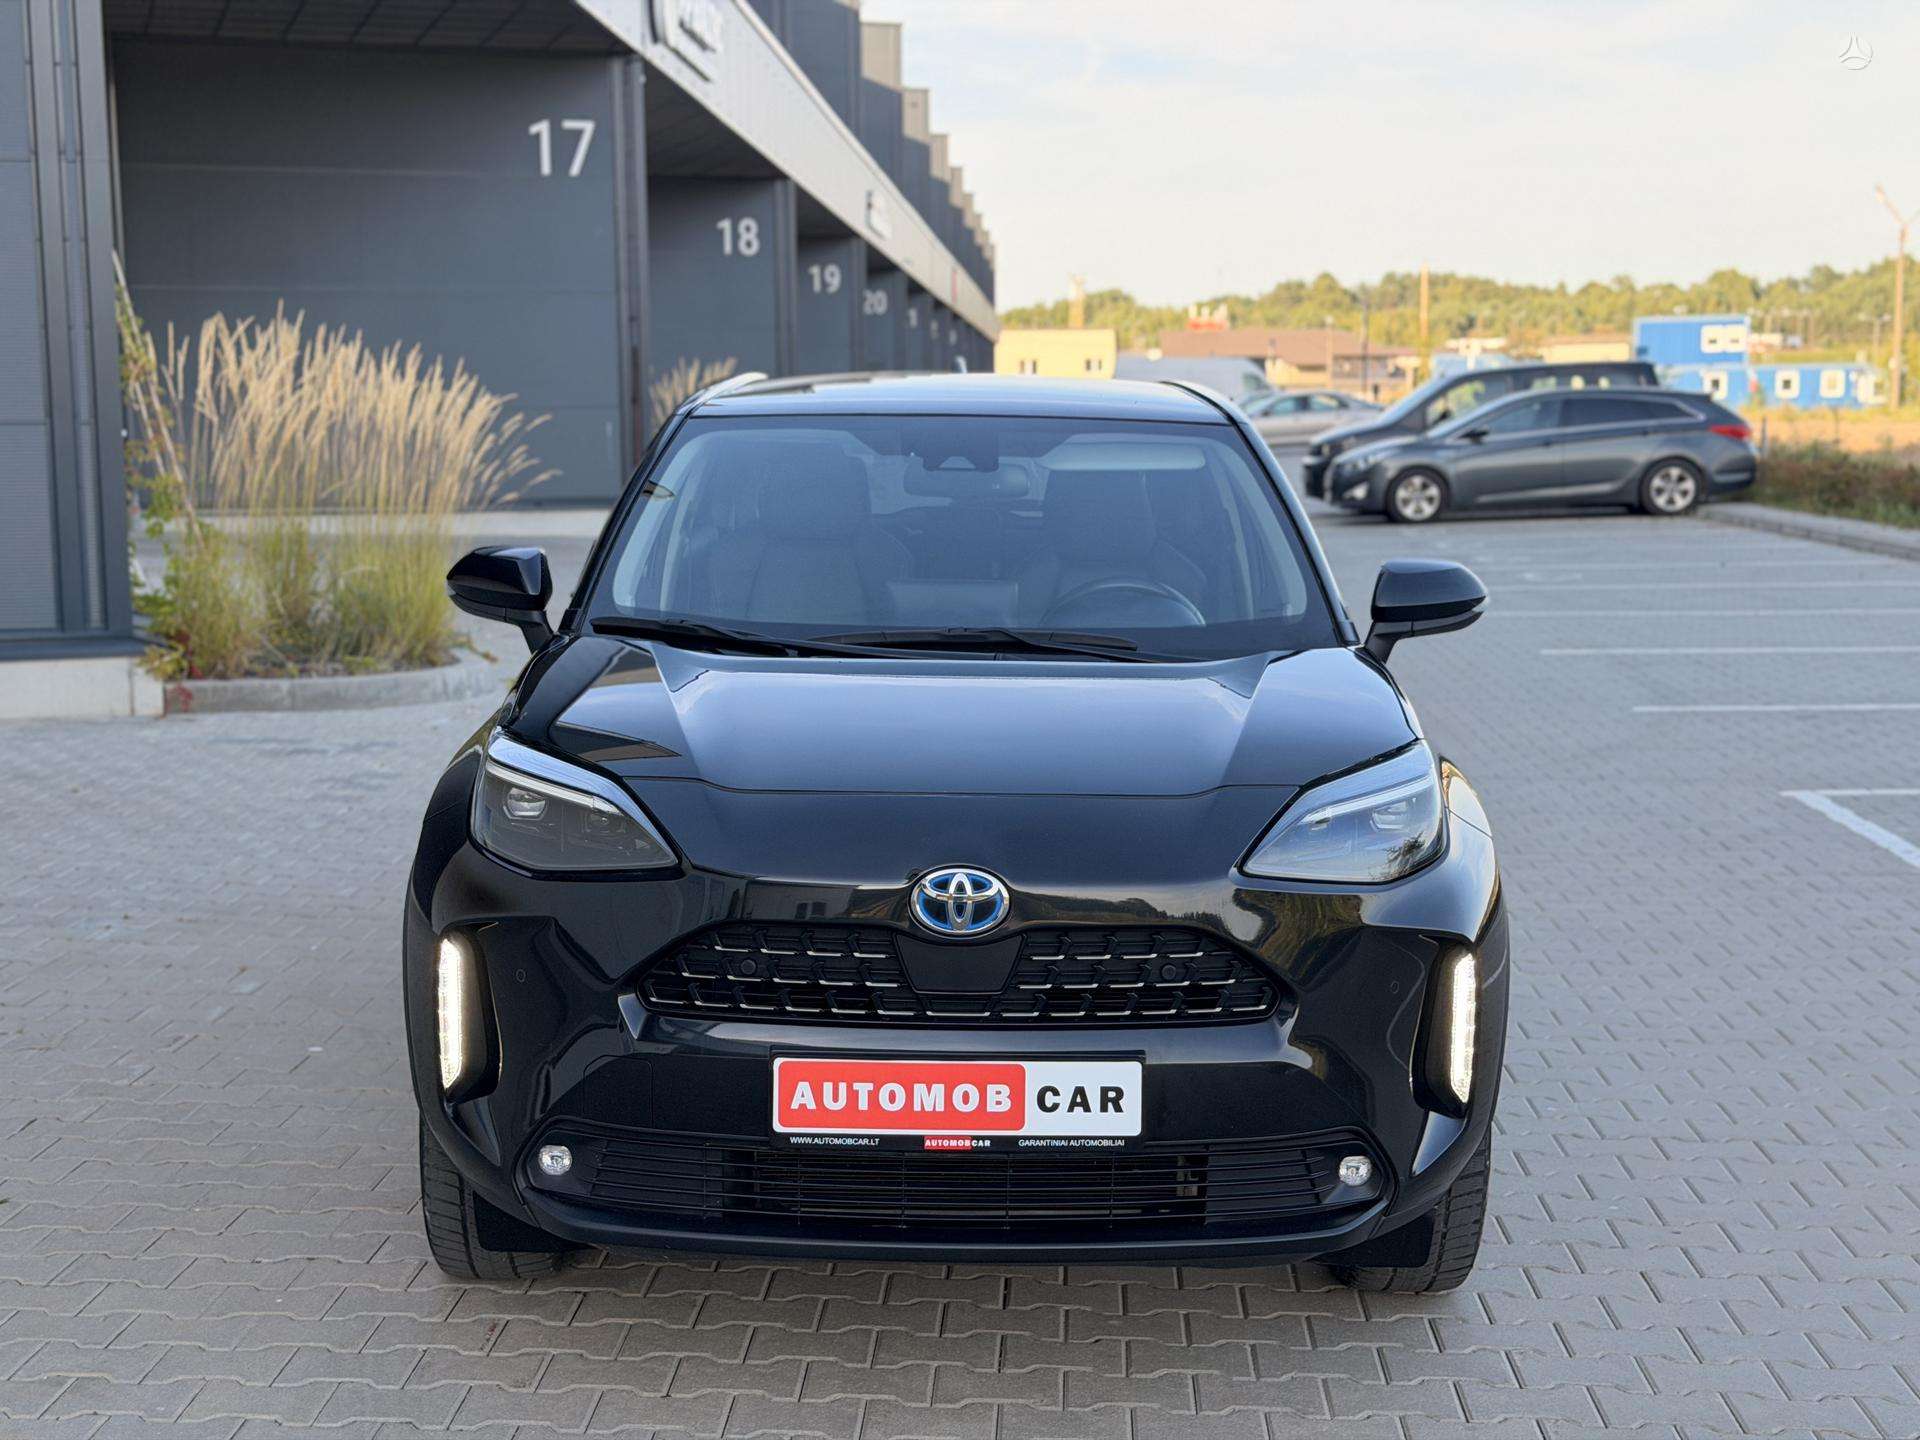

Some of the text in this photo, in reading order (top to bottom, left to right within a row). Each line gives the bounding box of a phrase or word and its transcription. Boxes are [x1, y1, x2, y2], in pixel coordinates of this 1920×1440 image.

[528, 119, 596, 177] 17
[716, 218, 760, 257] 18
[808, 265, 842, 294] 19
[863, 289, 888, 315] 20
[790, 1081, 1125, 1113] AUTOMOB CAR
[789, 1136, 880, 1146] WWW.AUTOMOBCAR.LT
[1018, 1139, 1125, 1147] GARANTINIAI AUTOMOBILIAI
